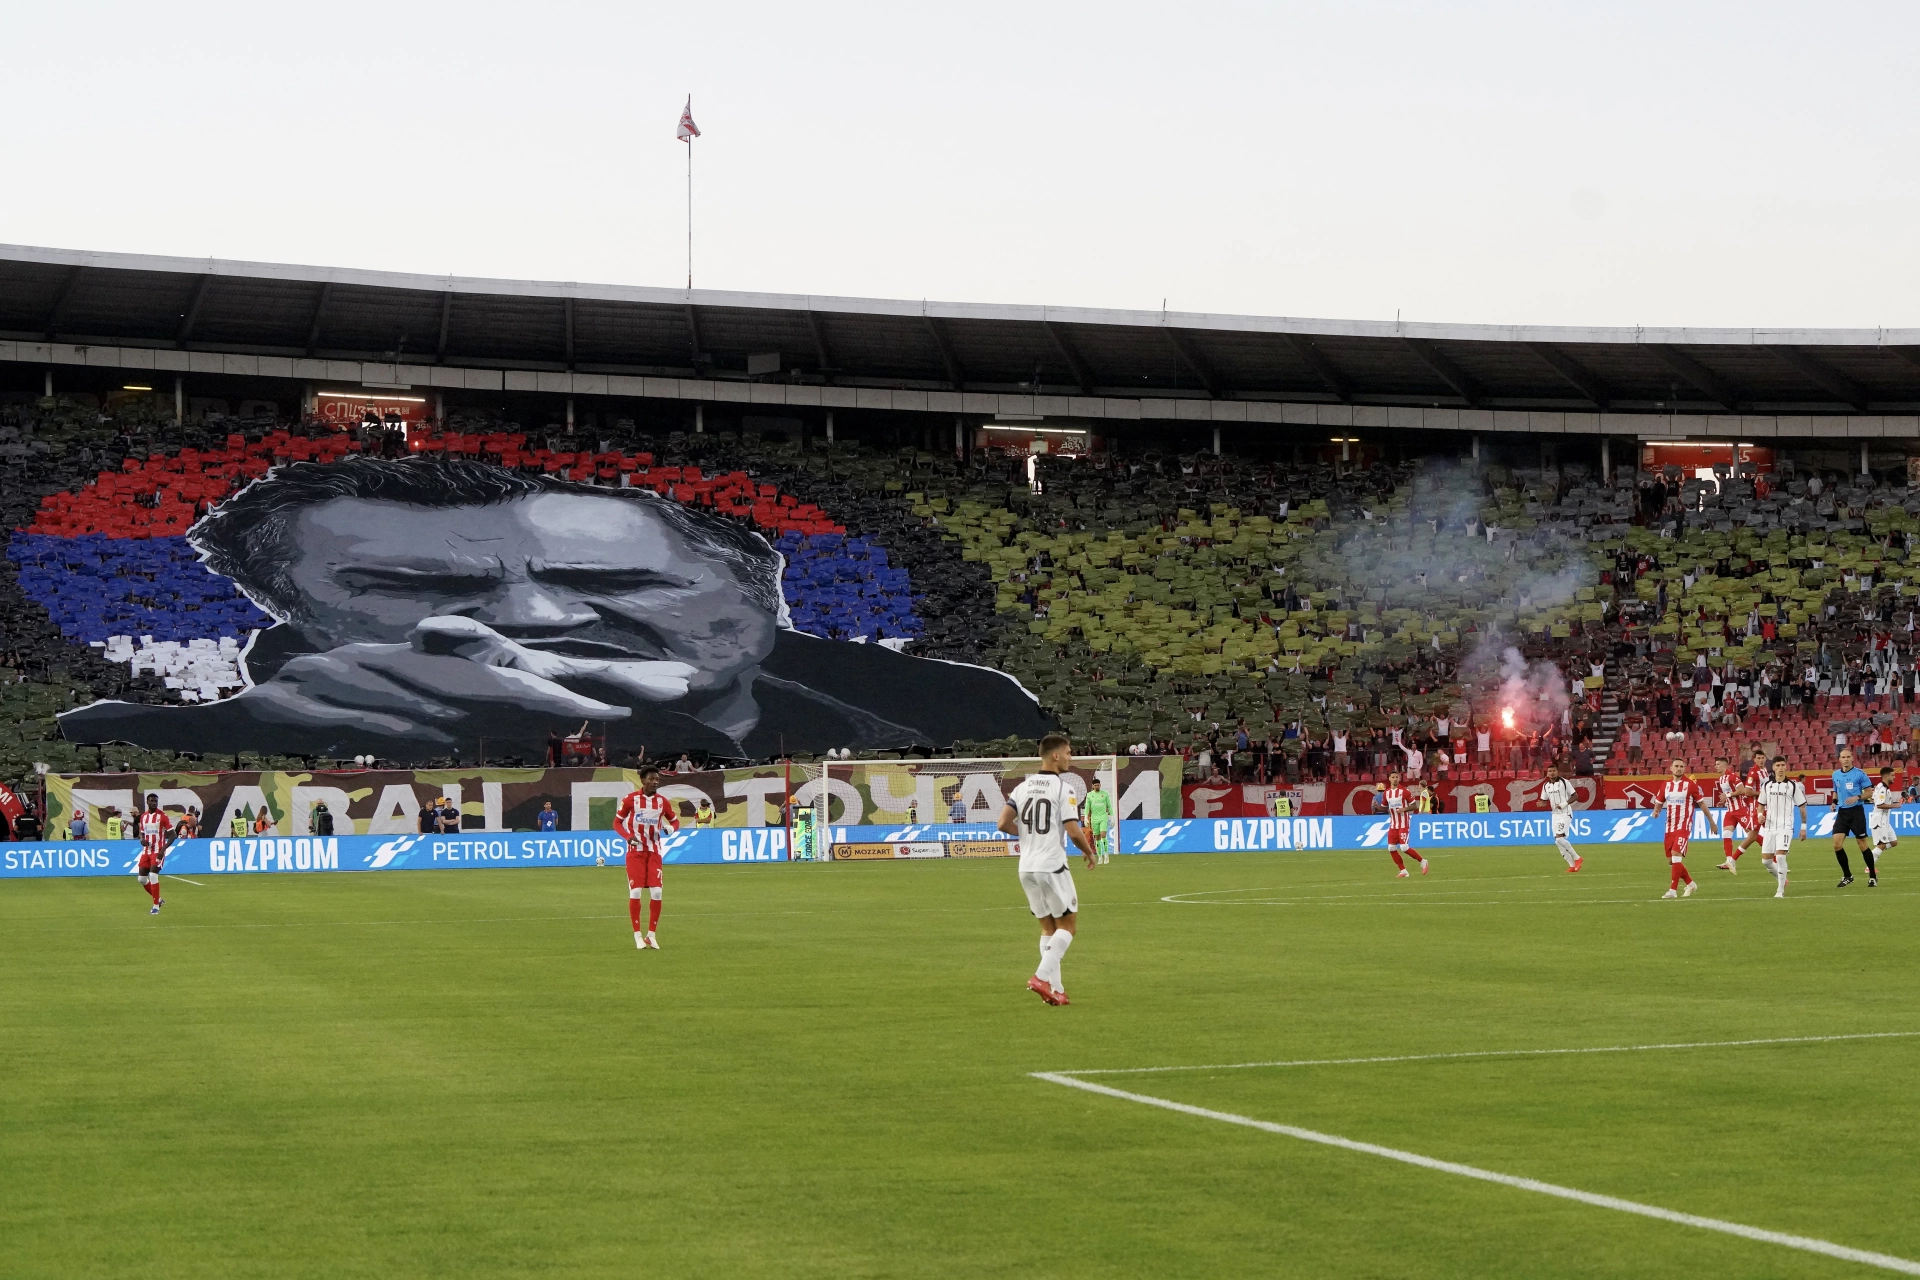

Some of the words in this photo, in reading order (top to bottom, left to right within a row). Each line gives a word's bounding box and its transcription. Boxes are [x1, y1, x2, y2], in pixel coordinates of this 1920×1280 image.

[1021, 797, 1052, 835] 40
[1214, 818, 1333, 850] GAZPROM
[1419, 821, 1495, 840] PETROL
[1499, 818, 1592, 839] STATINS
[5, 849, 110, 870] STATIONS
[210, 838, 339, 872] GAZPROM
[433, 841, 517, 861] PETROL
[522, 838, 625, 859] STATIONS
[854, 848, 891, 856] MOZZART
